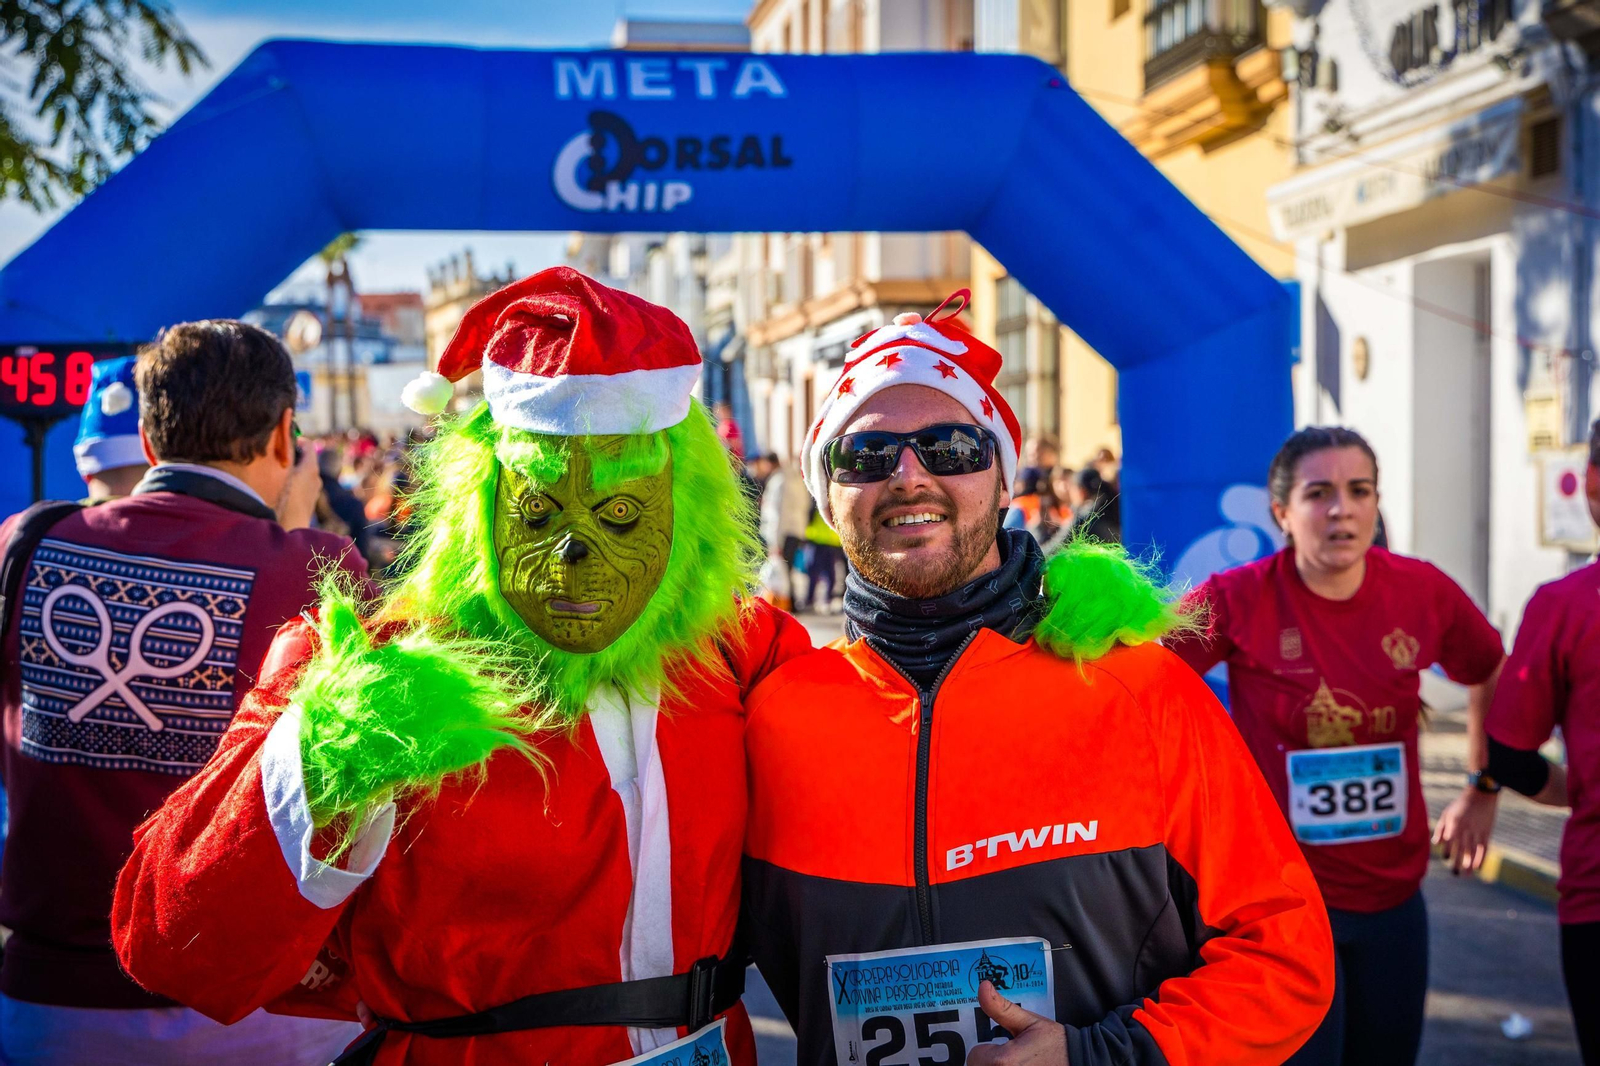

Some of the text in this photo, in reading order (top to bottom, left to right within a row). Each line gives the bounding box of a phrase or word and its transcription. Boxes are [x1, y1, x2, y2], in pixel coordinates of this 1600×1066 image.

[554, 58, 788, 99] META
[553, 130, 694, 212] CHIP
[588, 111, 793, 192] DORSAL
[1369, 706, 1396, 733] 10
[1309, 778, 1394, 816] 382
[834, 971, 851, 1004] X
[893, 959, 960, 982] SOLIDARIA
[1013, 963, 1028, 980] 10
[850, 982, 934, 1005] DIVINA PASTORA
